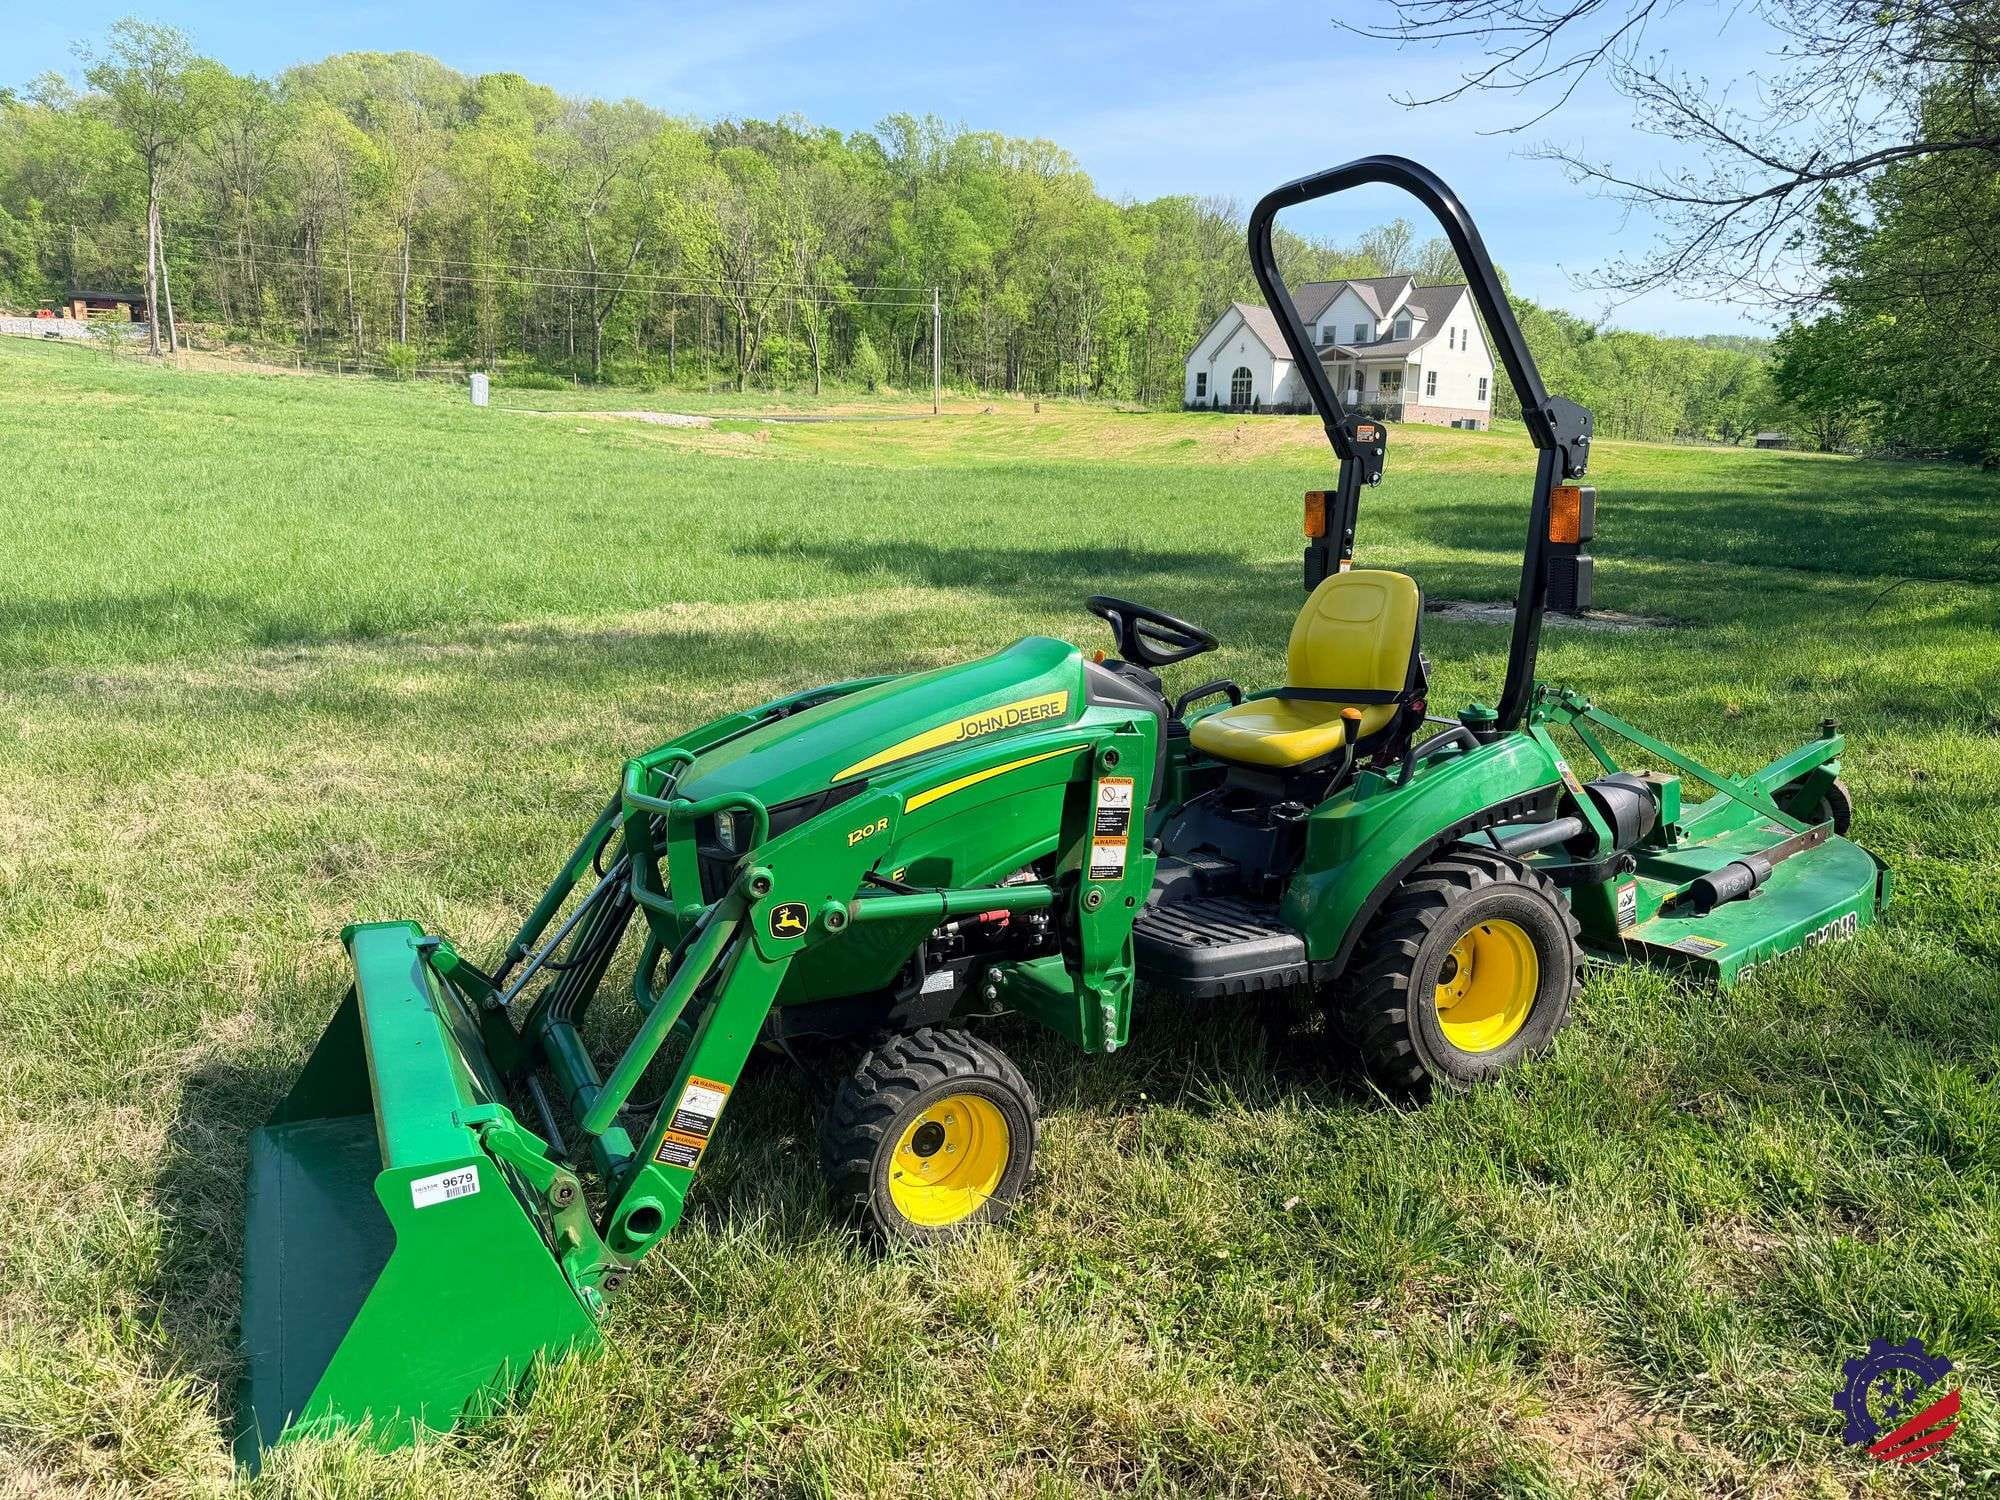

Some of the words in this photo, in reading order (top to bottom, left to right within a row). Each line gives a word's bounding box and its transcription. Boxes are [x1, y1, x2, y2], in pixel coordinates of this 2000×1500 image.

[956, 715, 1003, 740] JOHN
[1006, 701, 1060, 725] DEERE
[442, 1173, 473, 1188] 9679
